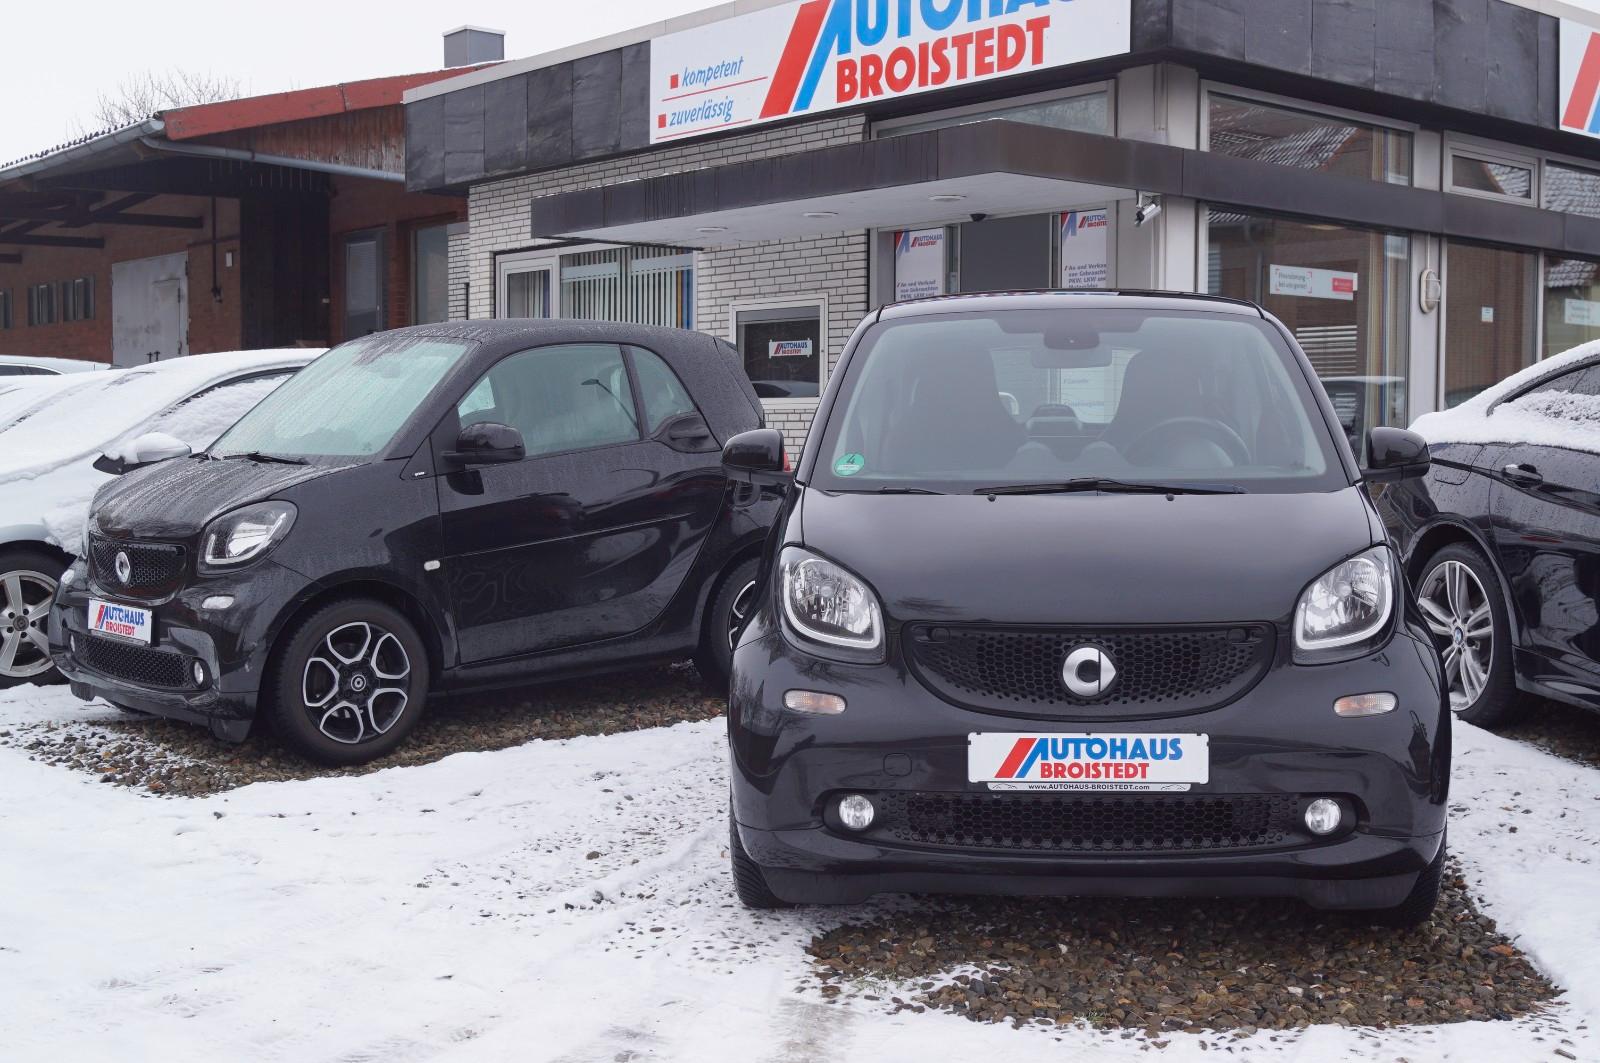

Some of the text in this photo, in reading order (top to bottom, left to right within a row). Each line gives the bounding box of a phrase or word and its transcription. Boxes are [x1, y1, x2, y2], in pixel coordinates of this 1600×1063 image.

[682, 56, 744, 87] kompetent
[836, 15, 1051, 104] BROISTEDT
[669, 96, 734, 127] zuverlässig
[100, 605, 144, 629] AUTOHAUS
[105, 620, 136, 636] BROISTEDT
[1015, 737, 1183, 779] AUTOHAUS
[1040, 762, 1150, 779] BROISTEDT
